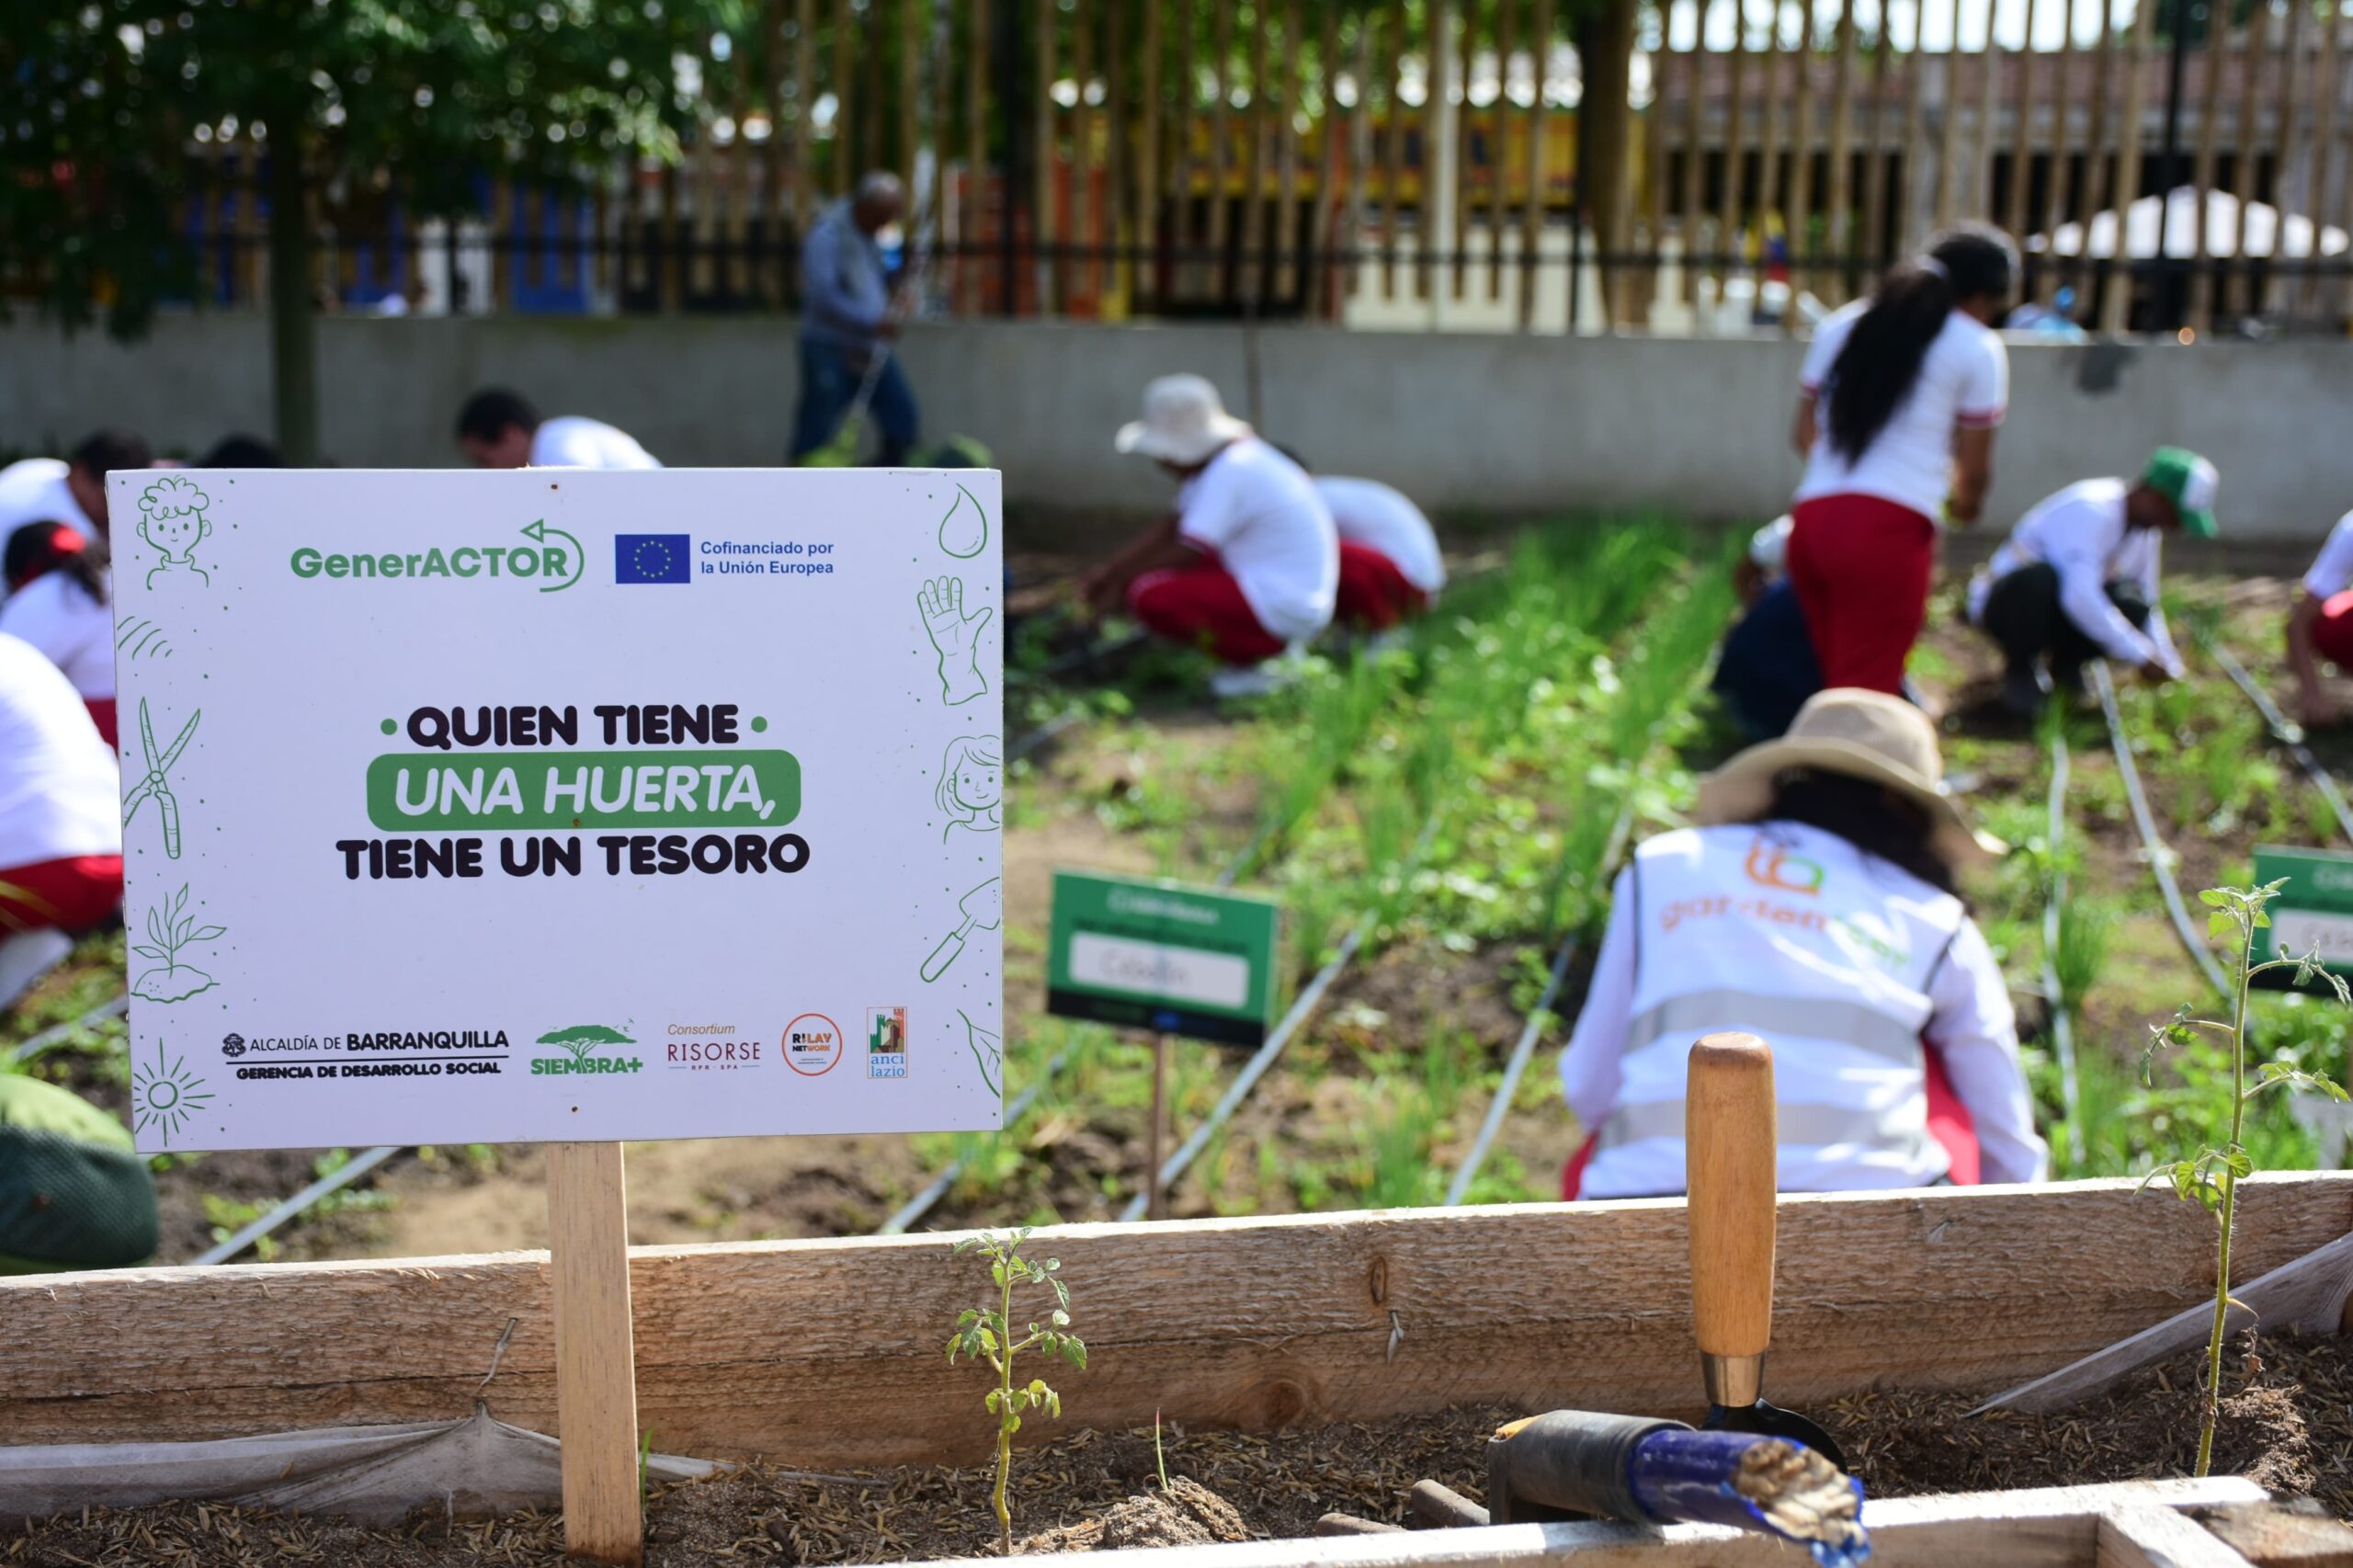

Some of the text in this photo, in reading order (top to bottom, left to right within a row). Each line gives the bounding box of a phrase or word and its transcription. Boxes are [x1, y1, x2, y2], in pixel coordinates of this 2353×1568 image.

[700, 540, 835, 558] Cofinanciado por
[290, 546, 569, 579] GenerACTOR
[700, 559, 835, 576] la Unión Europea
[406, 703, 739, 751] QUIEN TIENE
[395, 764, 777, 820] UNA HUERTA,
[335, 833, 811, 880] TIENE UN TESORO
[667, 1023, 736, 1036] Consortium
[249, 1029, 510, 1051] ALCALDÍA DE BARRANQUILLA
[792, 1044, 831, 1052] NETWORK
[667, 1041, 761, 1062] RISORSE
[870, 1052, 905, 1065] anci
[236, 1058, 503, 1081] GERENCIA DE DESARROLLO SOCIAL
[530, 1056, 644, 1076] SIEMBRA+
[870, 1065, 905, 1077] lazio
